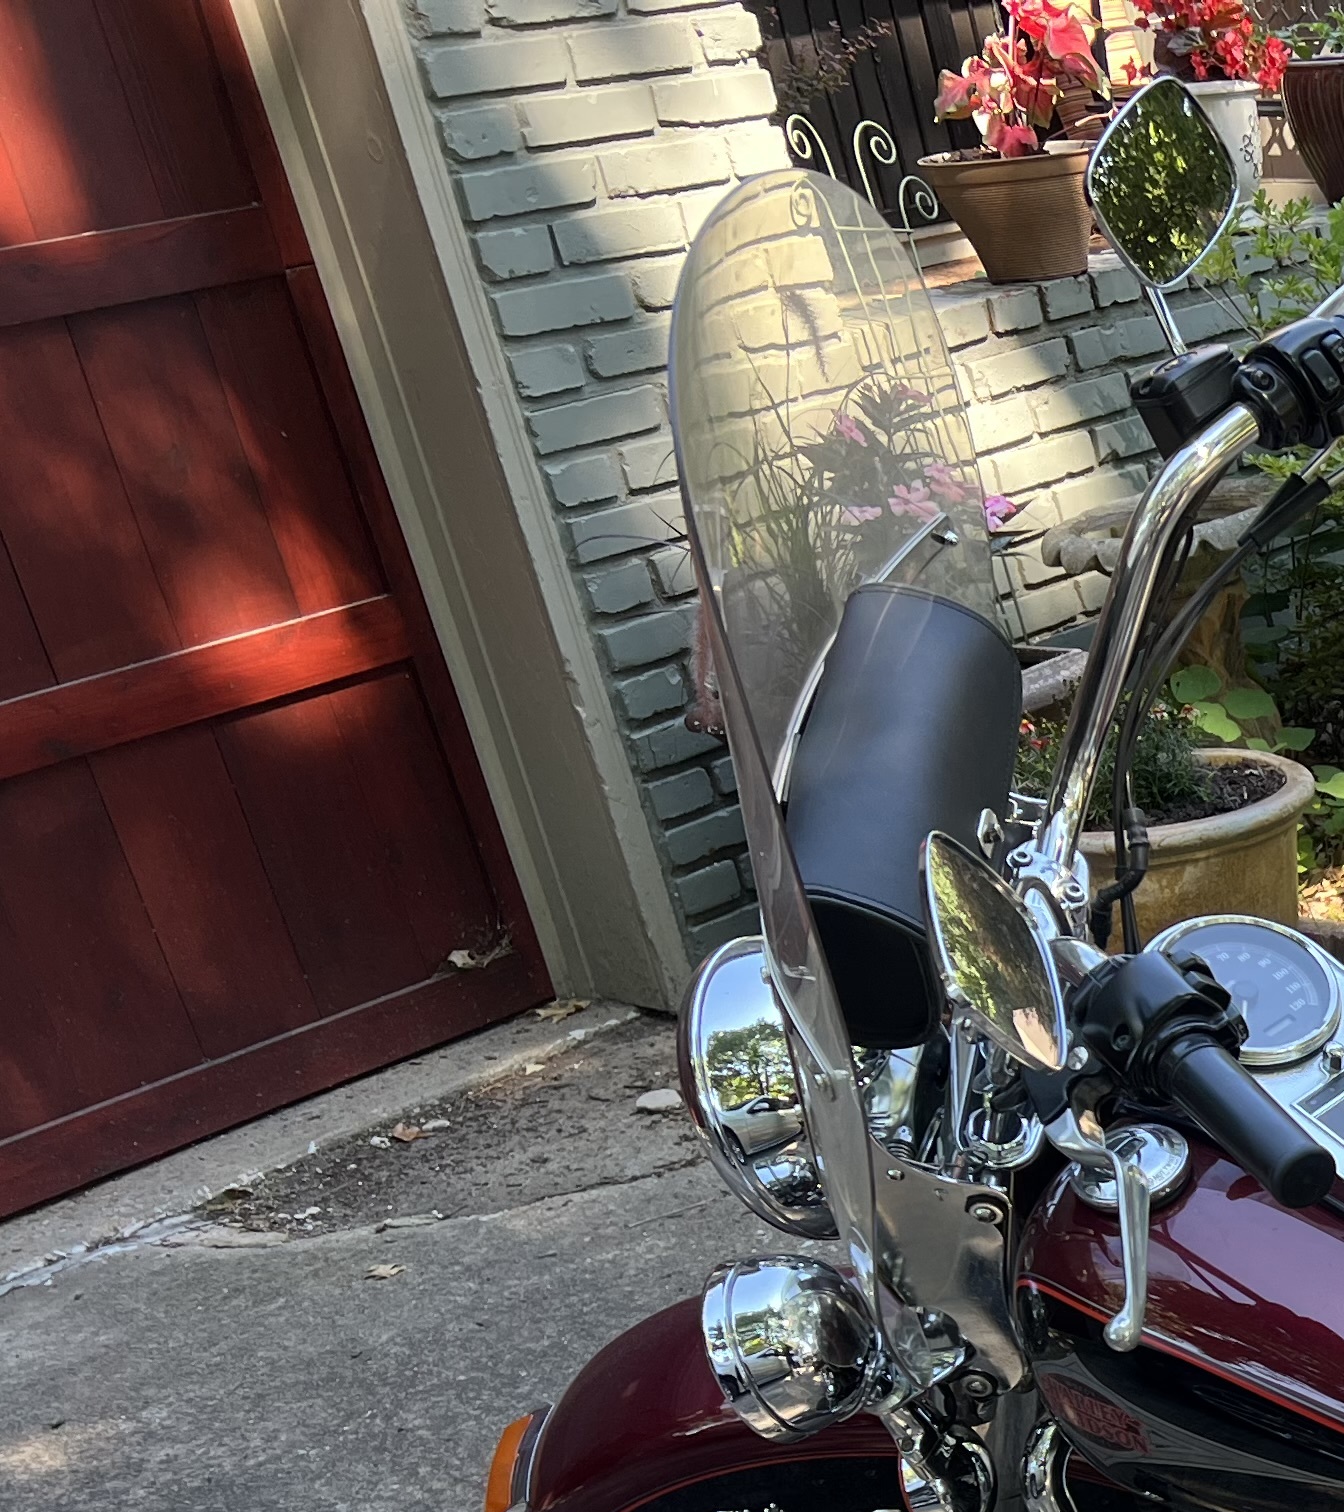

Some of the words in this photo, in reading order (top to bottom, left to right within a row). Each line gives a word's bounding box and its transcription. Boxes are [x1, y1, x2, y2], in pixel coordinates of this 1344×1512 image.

[1272, 968, 1289, 980] 100
[1285, 982, 1301, 994] 110
[1289, 998, 1306, 1012] 120
